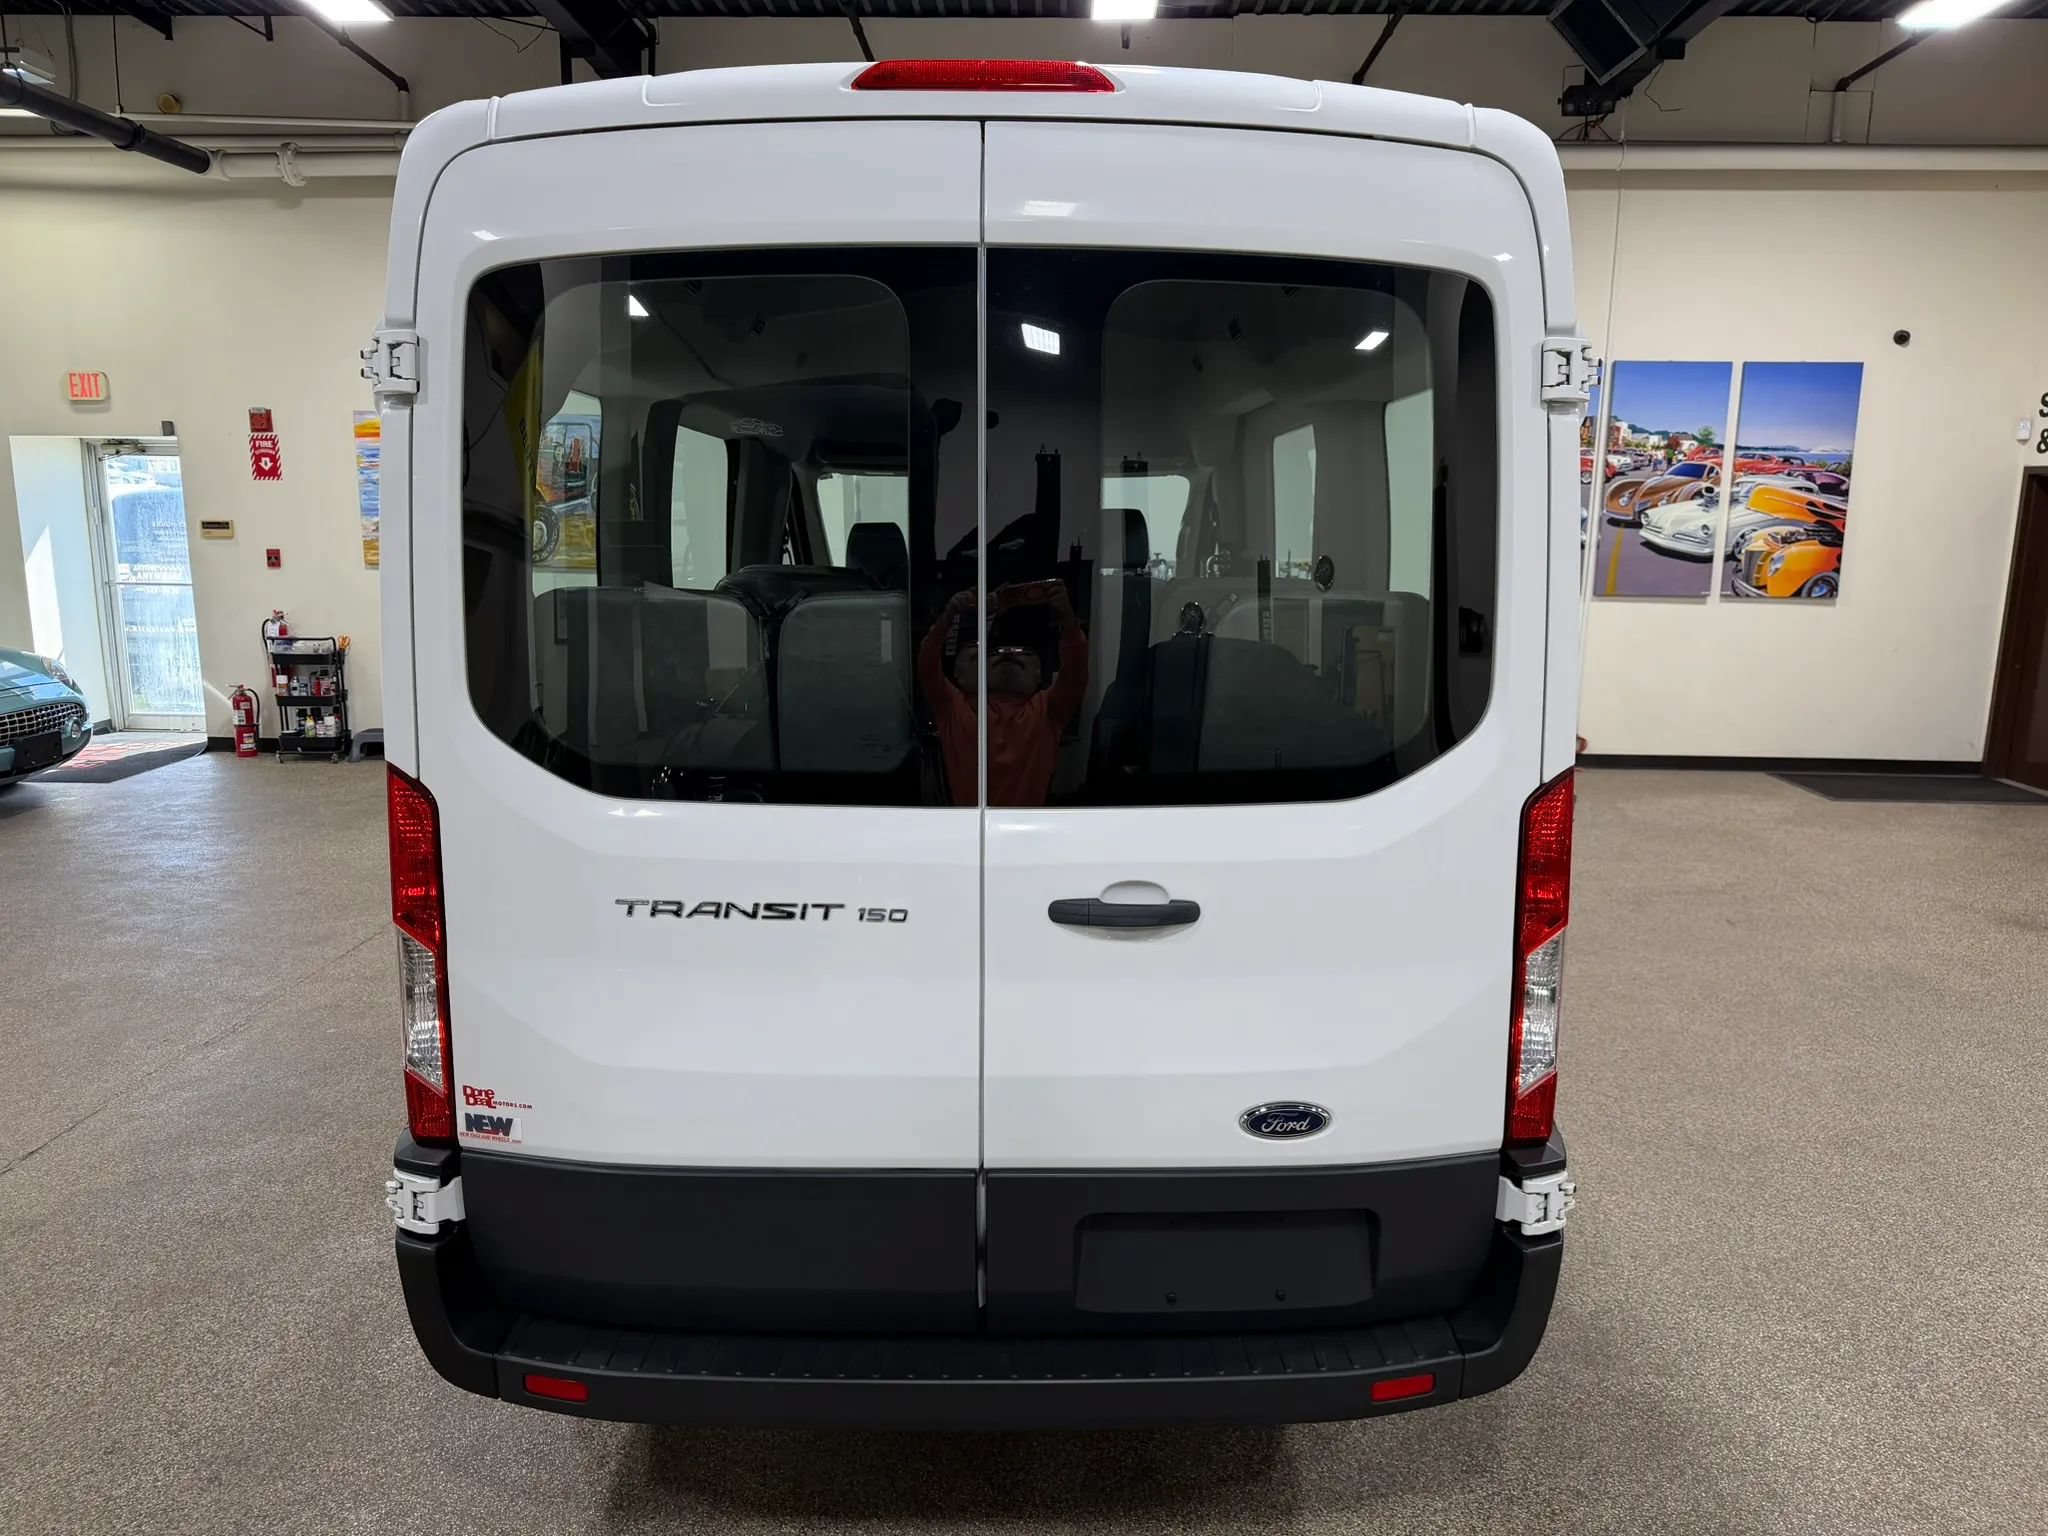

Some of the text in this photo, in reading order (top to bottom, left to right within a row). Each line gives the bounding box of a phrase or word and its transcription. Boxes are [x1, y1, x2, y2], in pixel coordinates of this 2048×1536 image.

[69, 373, 100, 398] EXIT
[255, 440, 273, 448] FIRE
[615, 898, 908, 923] TRANSIT 150
[463, 1085, 495, 1098] Done
[493, 1101, 533, 1109] MOTORS.COM
[465, 1112, 513, 1137] NEW
[1261, 1112, 1310, 1132] Ford
